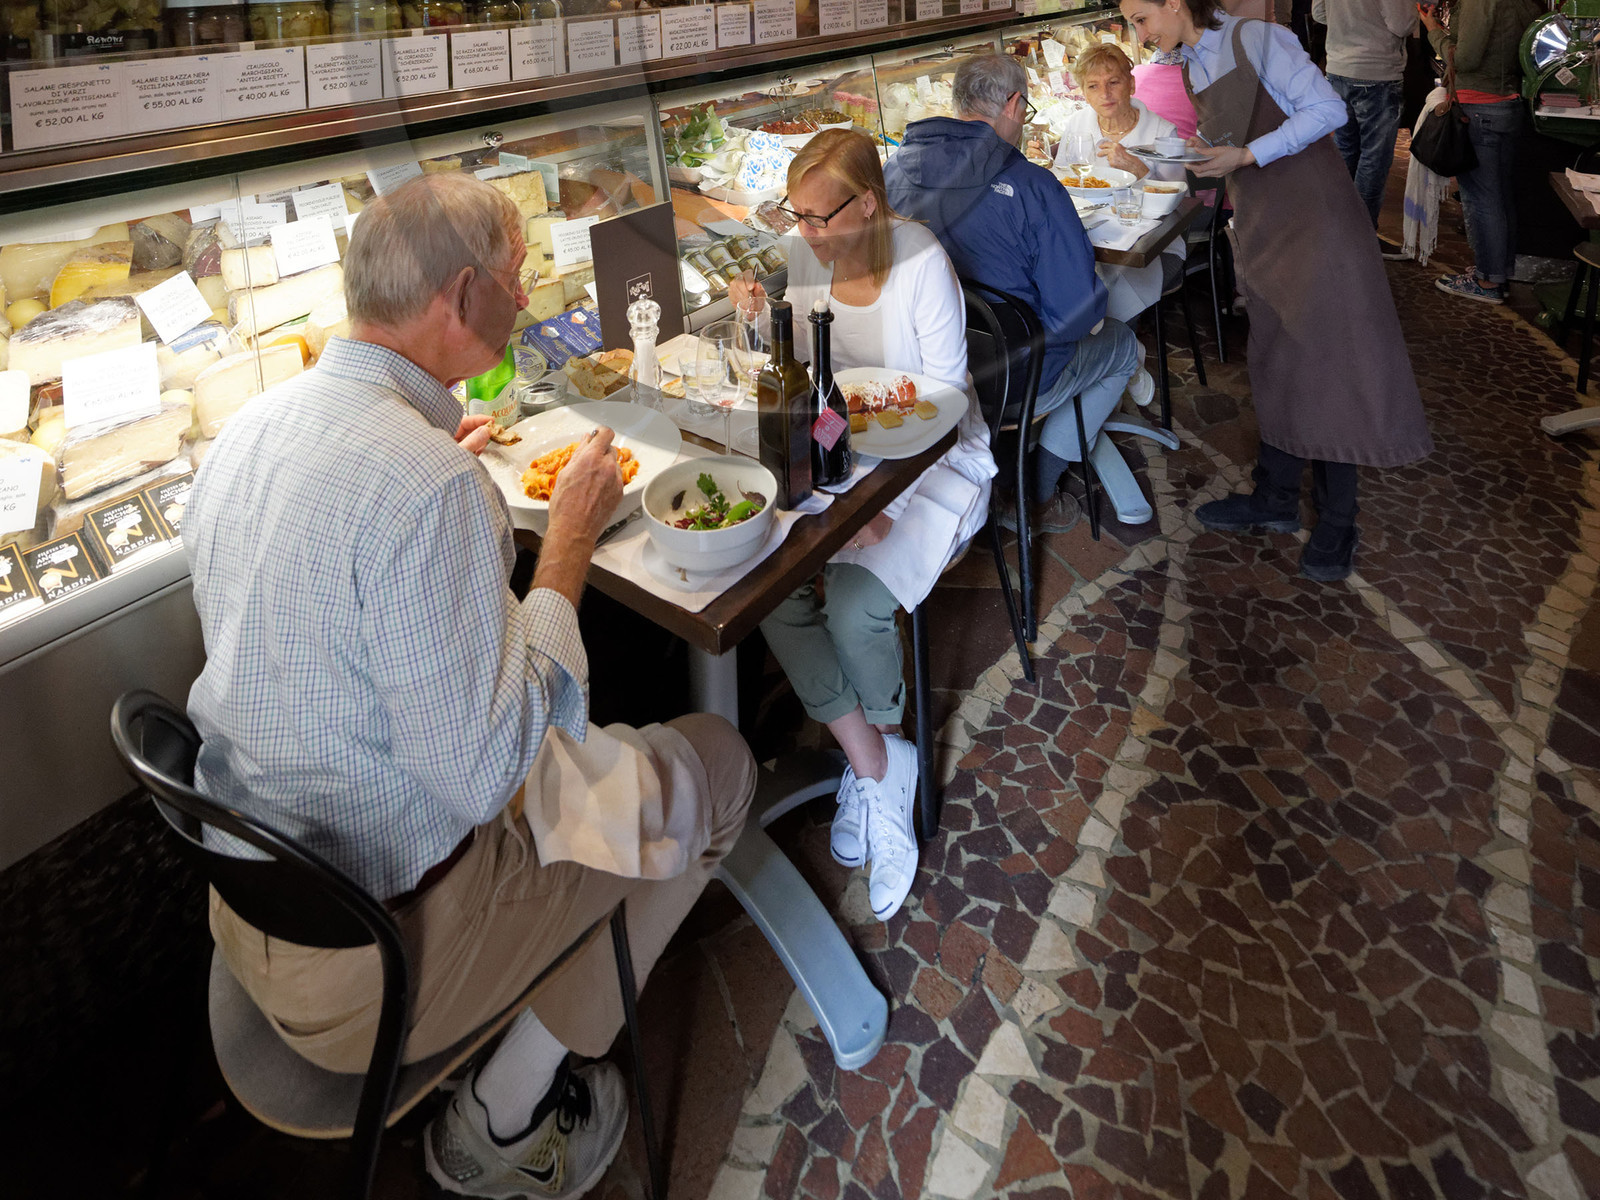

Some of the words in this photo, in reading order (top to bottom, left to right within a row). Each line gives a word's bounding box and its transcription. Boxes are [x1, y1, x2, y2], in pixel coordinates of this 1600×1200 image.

[246, 61, 280, 71] CIAUSCOLO
[24, 84, 56, 94] SALAME
[58, 78, 111, 90] CRESPONETTO
[132, 76, 159, 86] SALAME
[170, 73, 192, 81] RAZZA
[193, 71, 210, 79] NERA
[64, 88, 86, 96] VARZI
[246, 91, 267, 101] 40,00
[269, 90, 279, 98] AL
[280, 88, 291, 96] KG
[143, 102, 150, 110] €
[152, 99, 176, 109] 55,00
[179, 97, 190, 105] AL
[192, 95, 204, 104] KG
[36, 120, 43, 128] €
[45, 116, 74, 127] 52,00
[77, 114, 89, 123] AL
[92, 111, 105, 121] KG
[3, 503, 16, 512] KG
[115, 534, 157, 557] NARDÍN
[47, 574, 92, 600] NARDÍN
